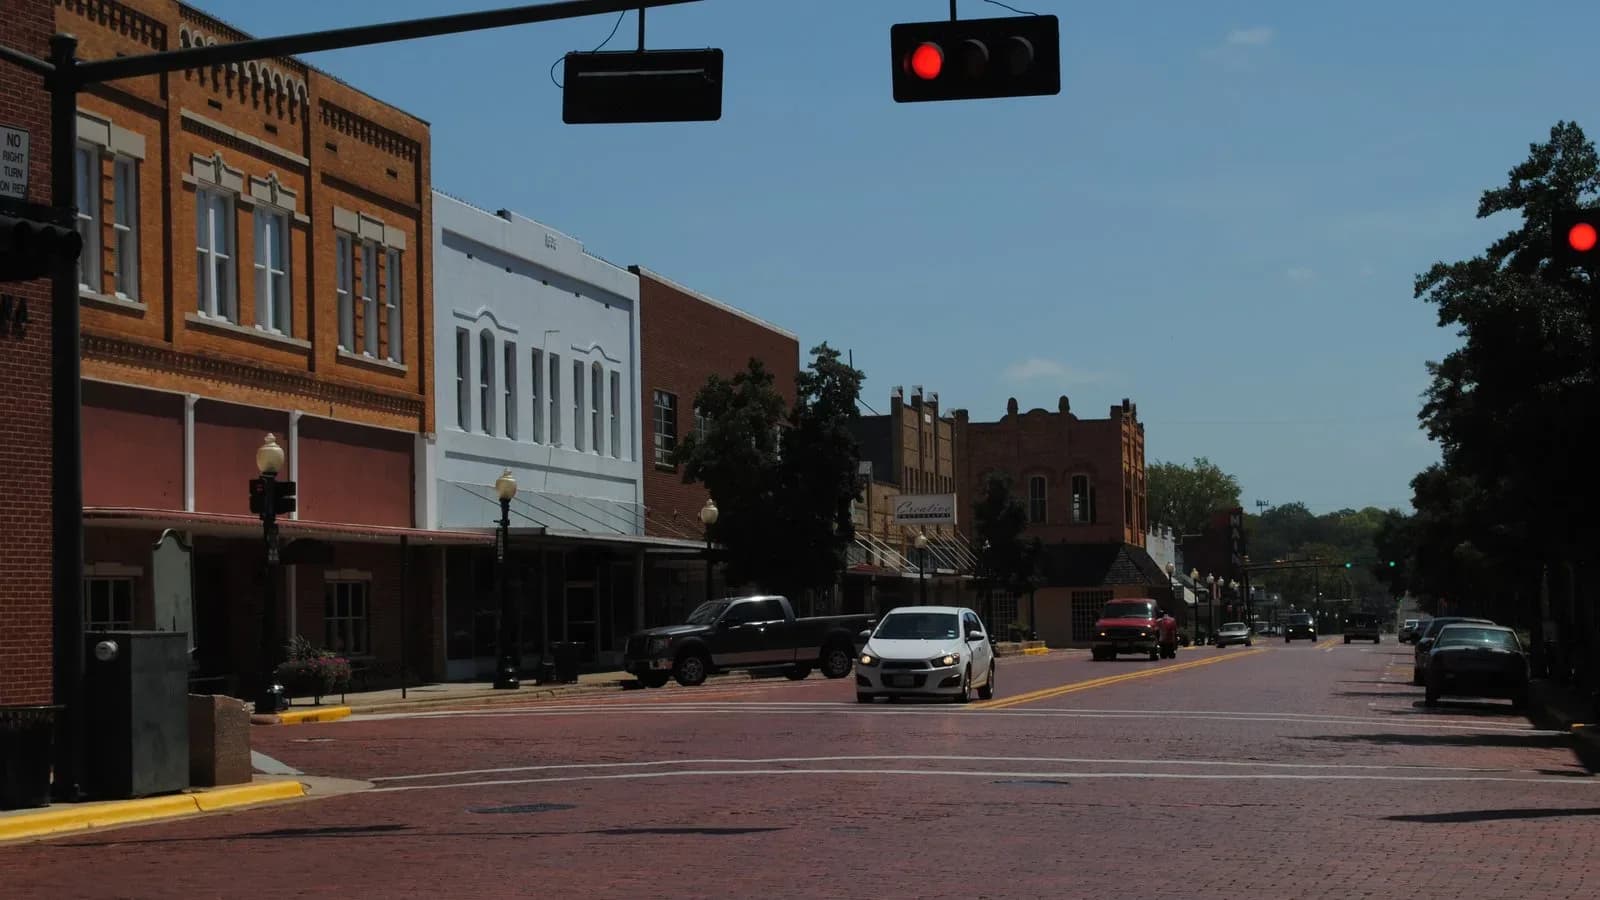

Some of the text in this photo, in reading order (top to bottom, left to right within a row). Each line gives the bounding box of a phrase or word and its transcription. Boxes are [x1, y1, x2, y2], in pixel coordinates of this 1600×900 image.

[6, 132, 21, 148] NO
[2, 150, 24, 164] RIGHT
[4, 165, 23, 179] TURN
[0, 180, 25, 195] ON RED
